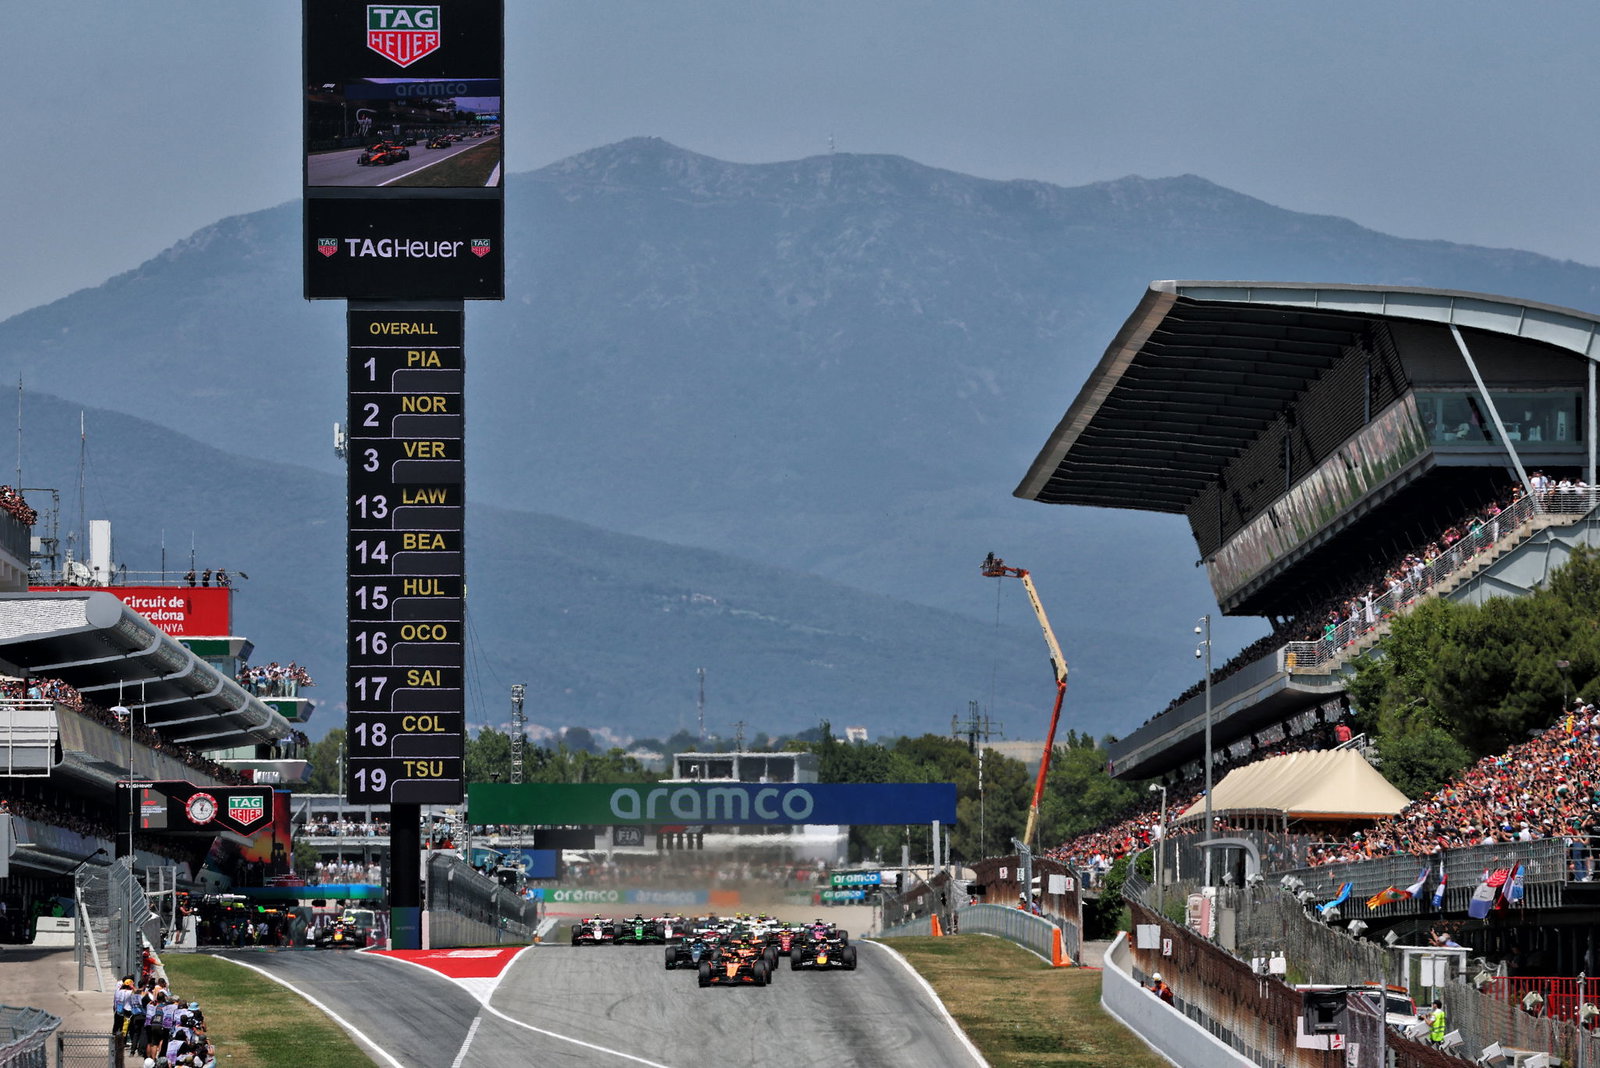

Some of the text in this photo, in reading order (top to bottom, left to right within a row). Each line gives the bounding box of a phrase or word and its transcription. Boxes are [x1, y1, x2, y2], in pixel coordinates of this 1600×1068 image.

[374, 10, 433, 27] TAG
[371, 34, 437, 62] HEUER
[396, 81, 468, 97] aramco
[370, 323, 437, 334] OVERALL
[364, 351, 440, 381] 1 PIA
[364, 397, 446, 426] 2 NOR
[364, 442, 445, 472] 3 VER
[356, 489, 447, 518] 13 LAW
[356, 534, 445, 564] 14 BEA
[123, 595, 184, 608] Circuit de
[356, 579, 444, 609] 15 HUL
[356, 625, 447, 654] 16 OCO
[355, 670, 441, 700] 17 SAI
[355, 715, 446, 746] 18 COL
[355, 761, 442, 792] 19 TSU
[230, 809, 262, 823] HEUER
[231, 798, 262, 807] TAG
[609, 787, 815, 820] aramco
[833, 874, 878, 884] aramco
[553, 889, 618, 901] aramco
